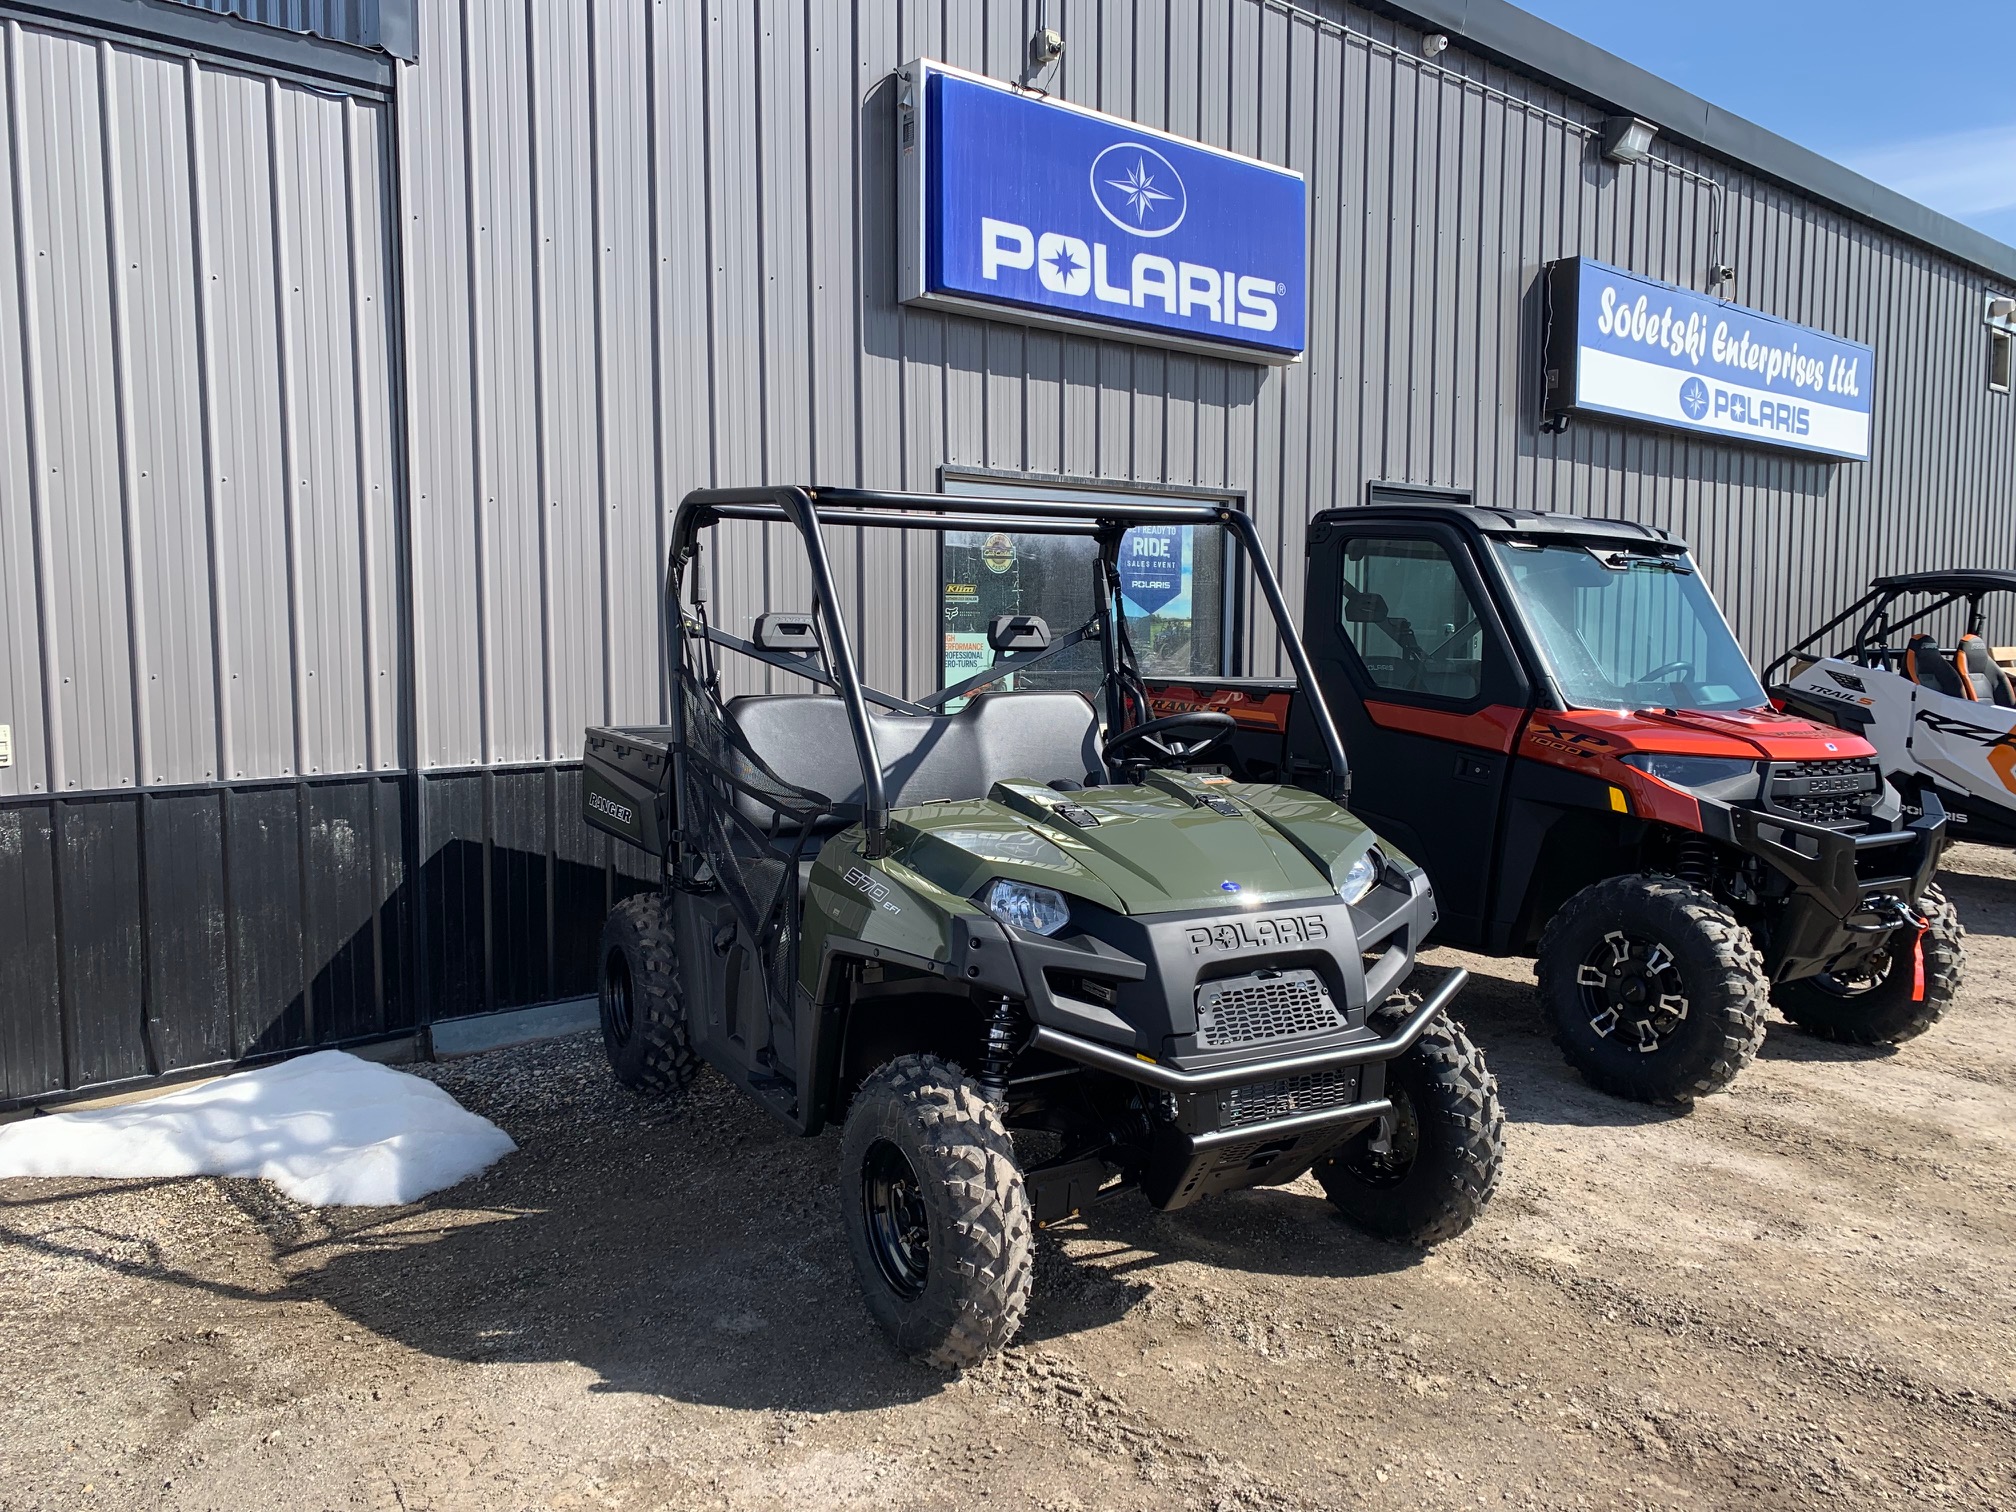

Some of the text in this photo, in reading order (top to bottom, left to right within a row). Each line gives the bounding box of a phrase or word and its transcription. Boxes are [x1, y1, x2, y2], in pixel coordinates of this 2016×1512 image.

[982, 216, 1278, 332] POLARIS
[1598, 286, 1860, 398] Sobetski Enterprises Ltd.
[1714, 388, 1810, 436] POLARIS
[1142, 525, 1165, 535] READY
[1166, 526, 1177, 536] TO
[1132, 536, 1171, 559] RIDE
[1126, 560, 1176, 569] SALES EVENT
[1131, 580, 1171, 589] POLARIS
[945, 634, 956, 642] IGH
[945, 642, 984, 651] ERFORMANCE
[945, 651, 984, 660] ROFESSIONAL
[945, 659, 978, 668] ERO-TURNS
[1809, 684, 1876, 706] TRAIL S
[1530, 735, 1583, 756] 1000
[1537, 723, 1609, 747] XP
[1809, 777, 1860, 794] POLARIS
[589, 792, 632, 824] RANGER
[1901, 804, 1969, 823] PORIS
[843, 866, 902, 915] 570 EFI
[1185, 914, 1329, 955] POLARIS
